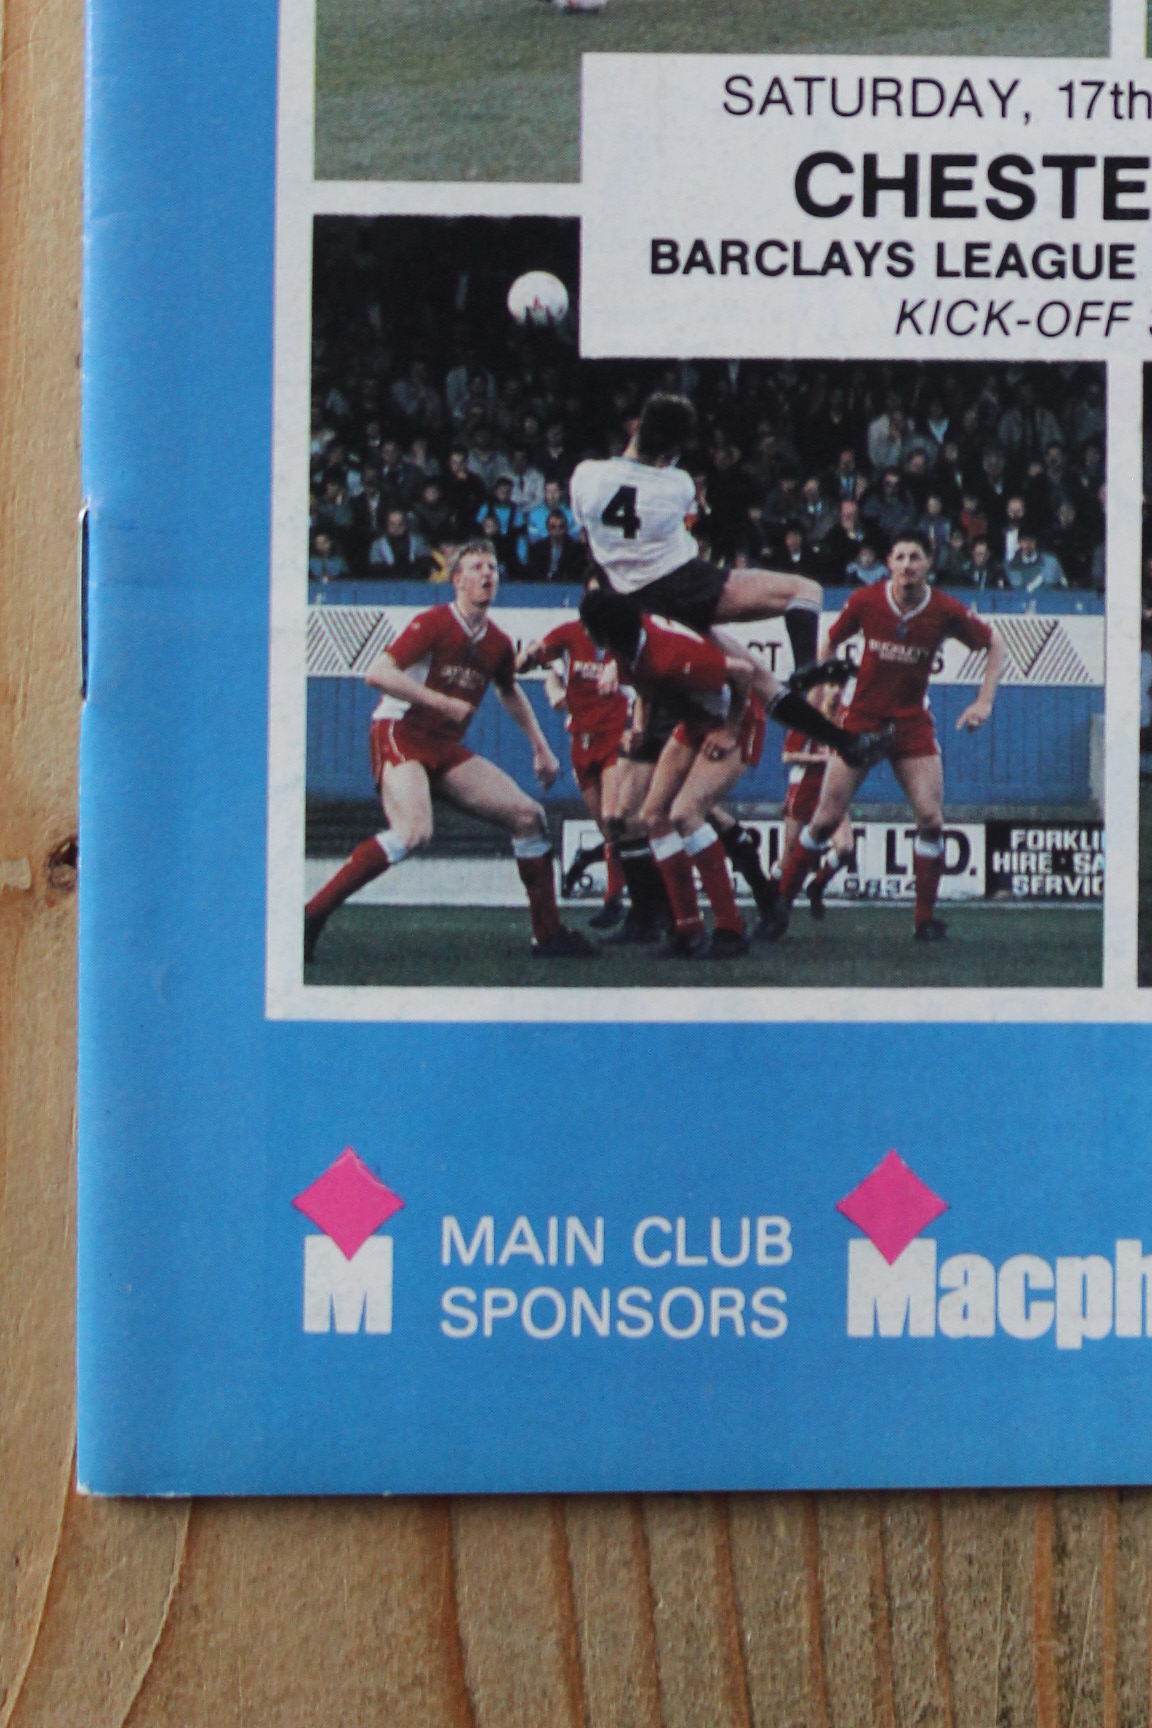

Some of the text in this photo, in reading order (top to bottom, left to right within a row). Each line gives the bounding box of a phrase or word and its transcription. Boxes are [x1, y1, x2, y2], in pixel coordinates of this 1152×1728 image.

[723, 74, 1031, 125] SATURDAY,
[1058, 80, 1152, 120] 17th
[650, 238, 915, 278] BARCLAYS
[936, 241, 1136, 281] LEAGUE
[895, 298, 1134, 338] KICK-OFF
[602, 484, 642, 540] 4
[992, 851, 1053, 874] HIRE
[441, 1214, 793, 1268] MAIN CLUB
[440, 1285, 789, 1340] SPONSORS
